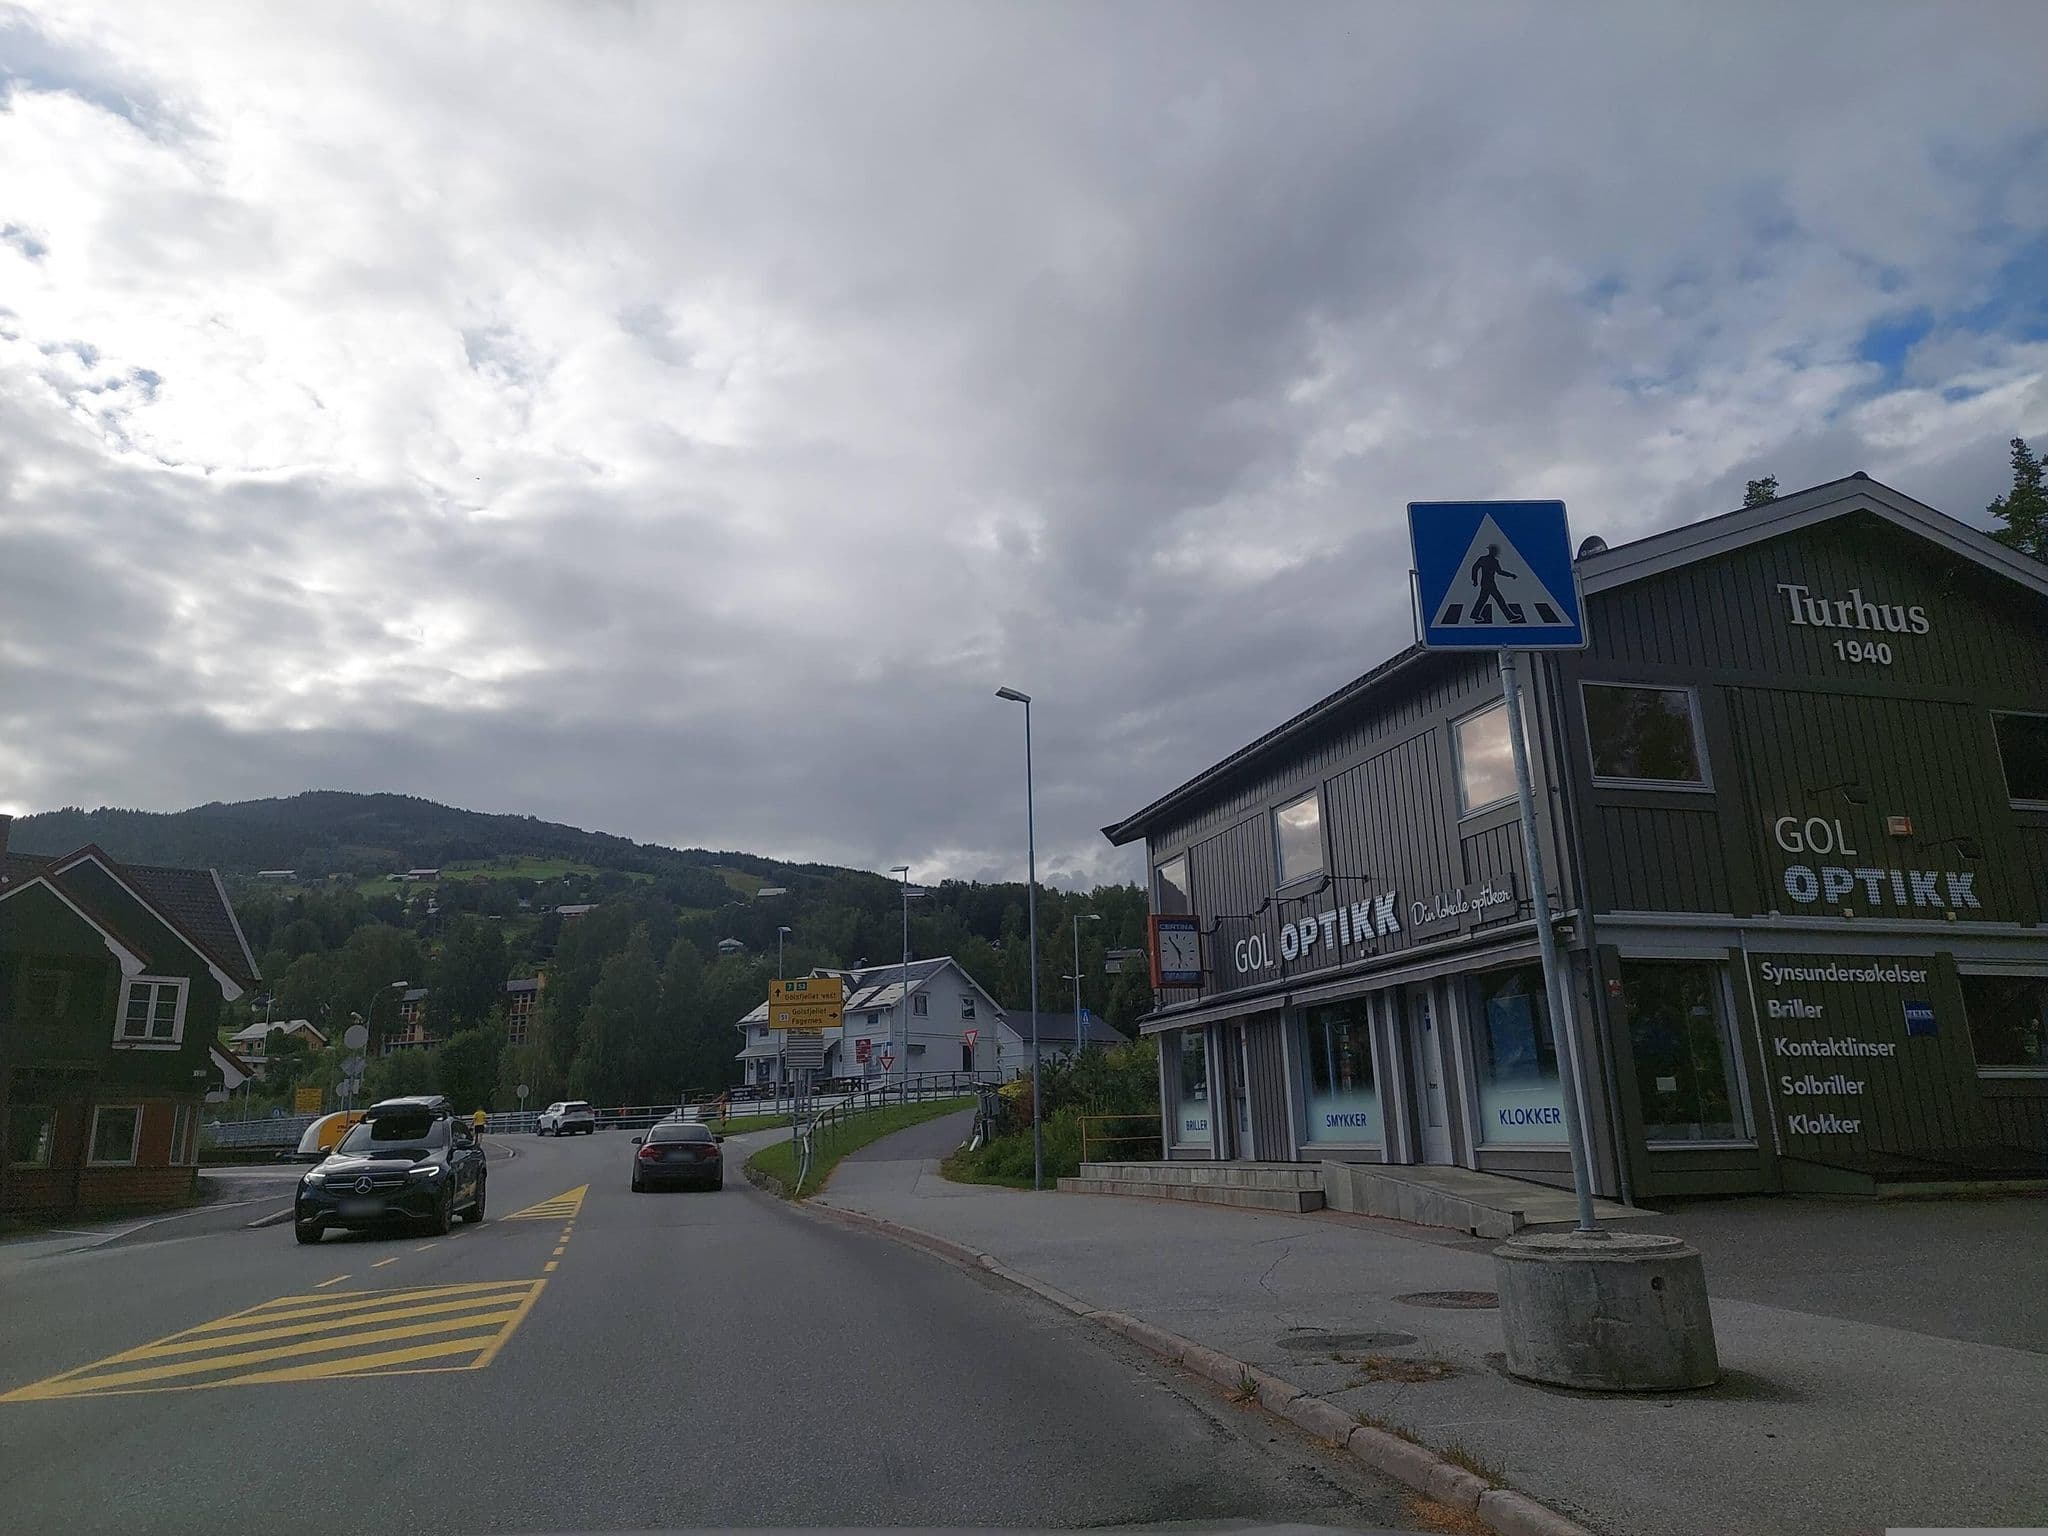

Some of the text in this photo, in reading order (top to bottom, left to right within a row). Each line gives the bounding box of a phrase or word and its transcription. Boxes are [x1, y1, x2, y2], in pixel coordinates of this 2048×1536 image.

[1777, 583, 1930, 635] Turhus
[1833, 639, 1892, 665] 1940
[1775, 816, 1858, 856] GOL
[1784, 864, 1982, 908] OPTIKK
[1411, 879, 1511, 925] Din lokale optiker
[1235, 890, 1401, 973] GOL OPTIKK
[1761, 962, 1927, 985] Synsundersøkelser
[1768, 999, 1824, 1019] Briller
[1775, 1037, 1896, 1057] Kontaktlinser
[1781, 1075, 1865, 1095] Solbriller
[1186, 1119, 1207, 1131] BRILLER
[1326, 1113, 1367, 1128] SMYKKER
[1499, 1107, 1561, 1125] KLOKKER
[1788, 1114, 1861, 1134] Klokker
